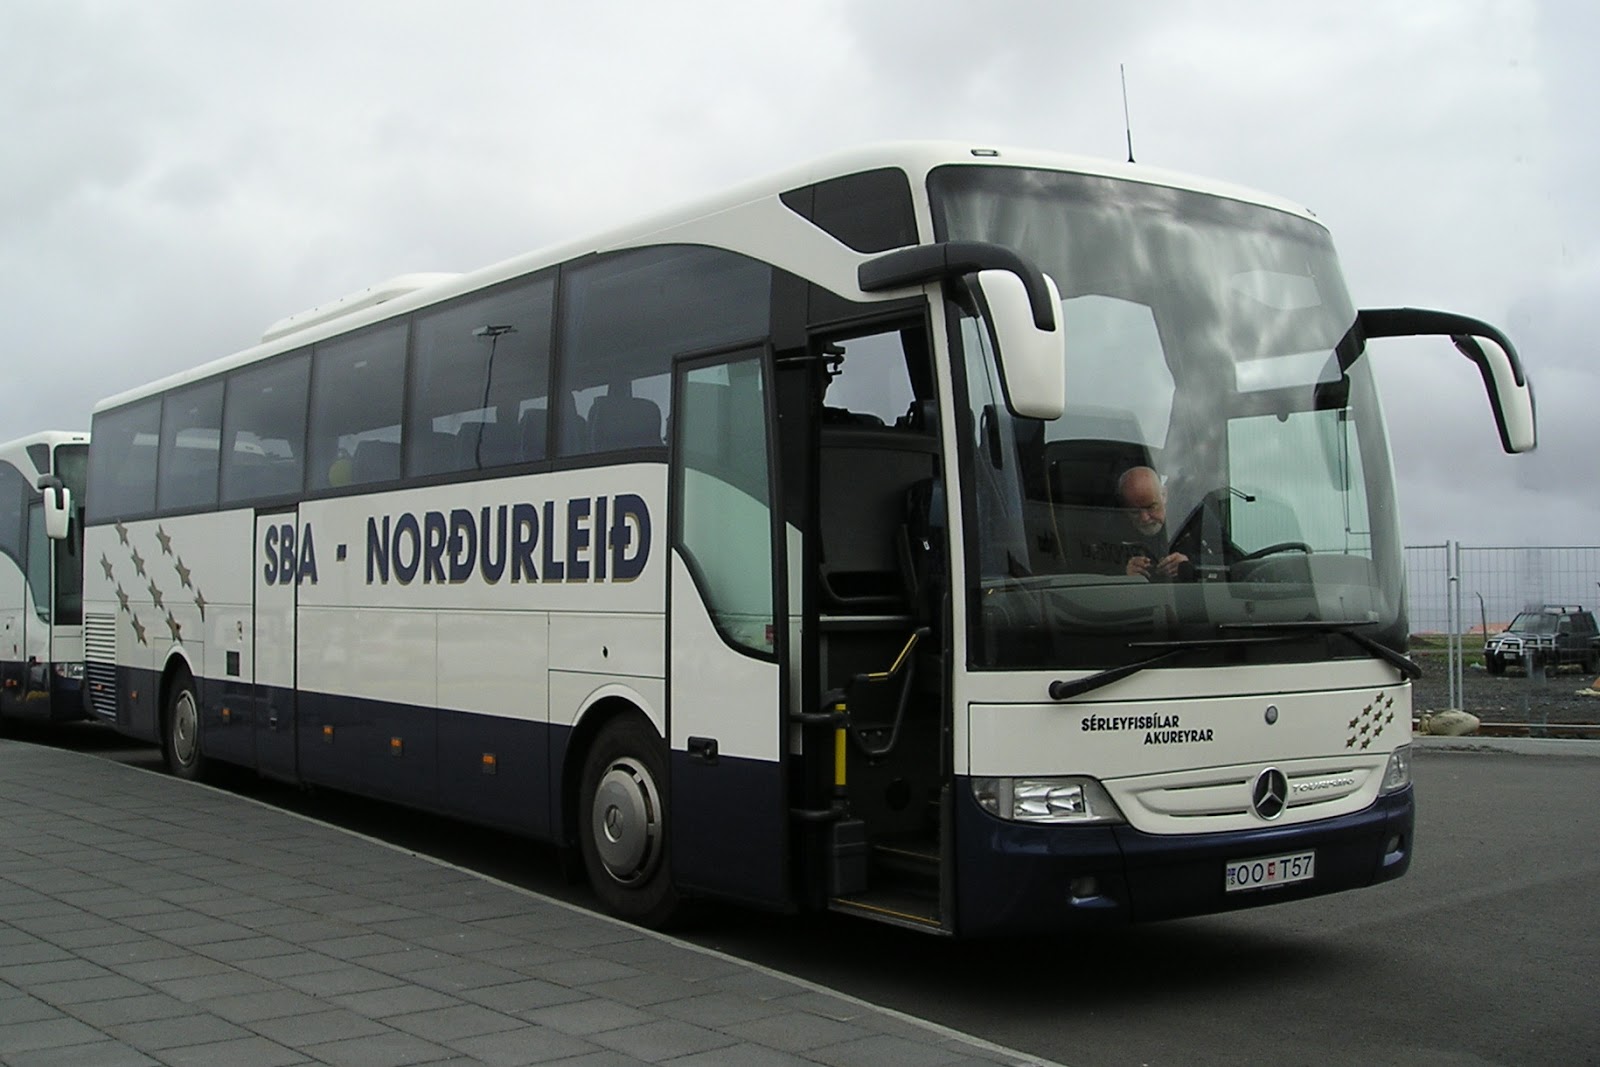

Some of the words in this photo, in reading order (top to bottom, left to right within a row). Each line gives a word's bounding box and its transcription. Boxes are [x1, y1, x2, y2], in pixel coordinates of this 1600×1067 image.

[264, 522, 318, 586] SBA
[366, 493, 652, 586] NORÐURLEIÐ
[1081, 713, 1180, 731] SÉRLEYFISBÍLAR
[1144, 729, 1214, 745] AKUREYRAR
